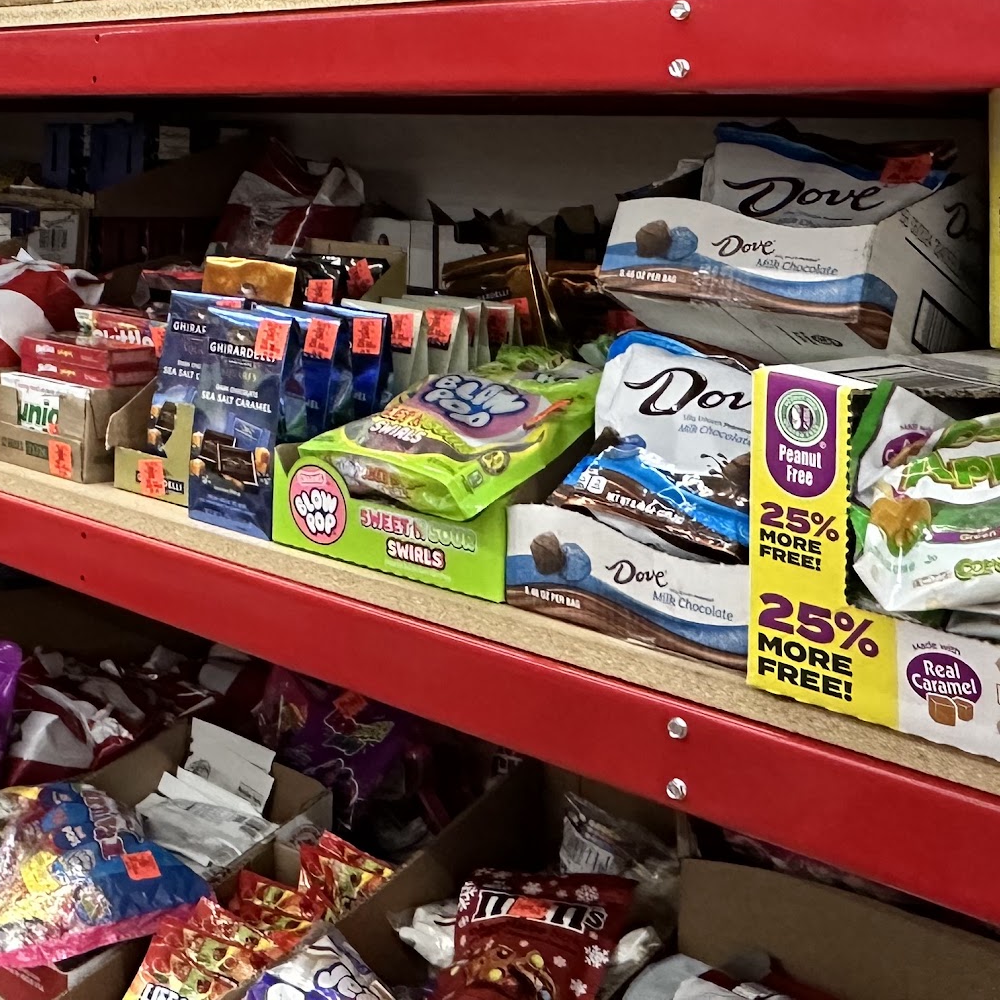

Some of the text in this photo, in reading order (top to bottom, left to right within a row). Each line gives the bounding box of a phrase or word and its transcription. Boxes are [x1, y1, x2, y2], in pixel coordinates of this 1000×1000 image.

[781, 258, 839, 276] Chocolate
[179, 368, 195, 379] SALT
[201, 390, 273, 414] SEA SALT CARAMEL
[370, 419, 429, 445] SWIRLS
[778, 443, 823, 470] Peanut
[786, 465, 814, 487] Free
[293, 487, 338, 517] BLOW
[305, 511, 338, 537] POP
[760, 501, 841, 543] 25%
[386, 537, 447, 571] SWIRLS
[759, 527, 823, 556] MORE
[759, 544, 823, 572] FREE!
[653, 589, 735, 623] Milk Chocolate
[758, 592, 880, 658] 25%
[758, 632, 853, 678] MORE
[912, 640, 939, 651] Made
[757, 655, 853, 702] FREE!
[922, 659, 962, 680] Real
[911, 673, 978, 696] Caramel
